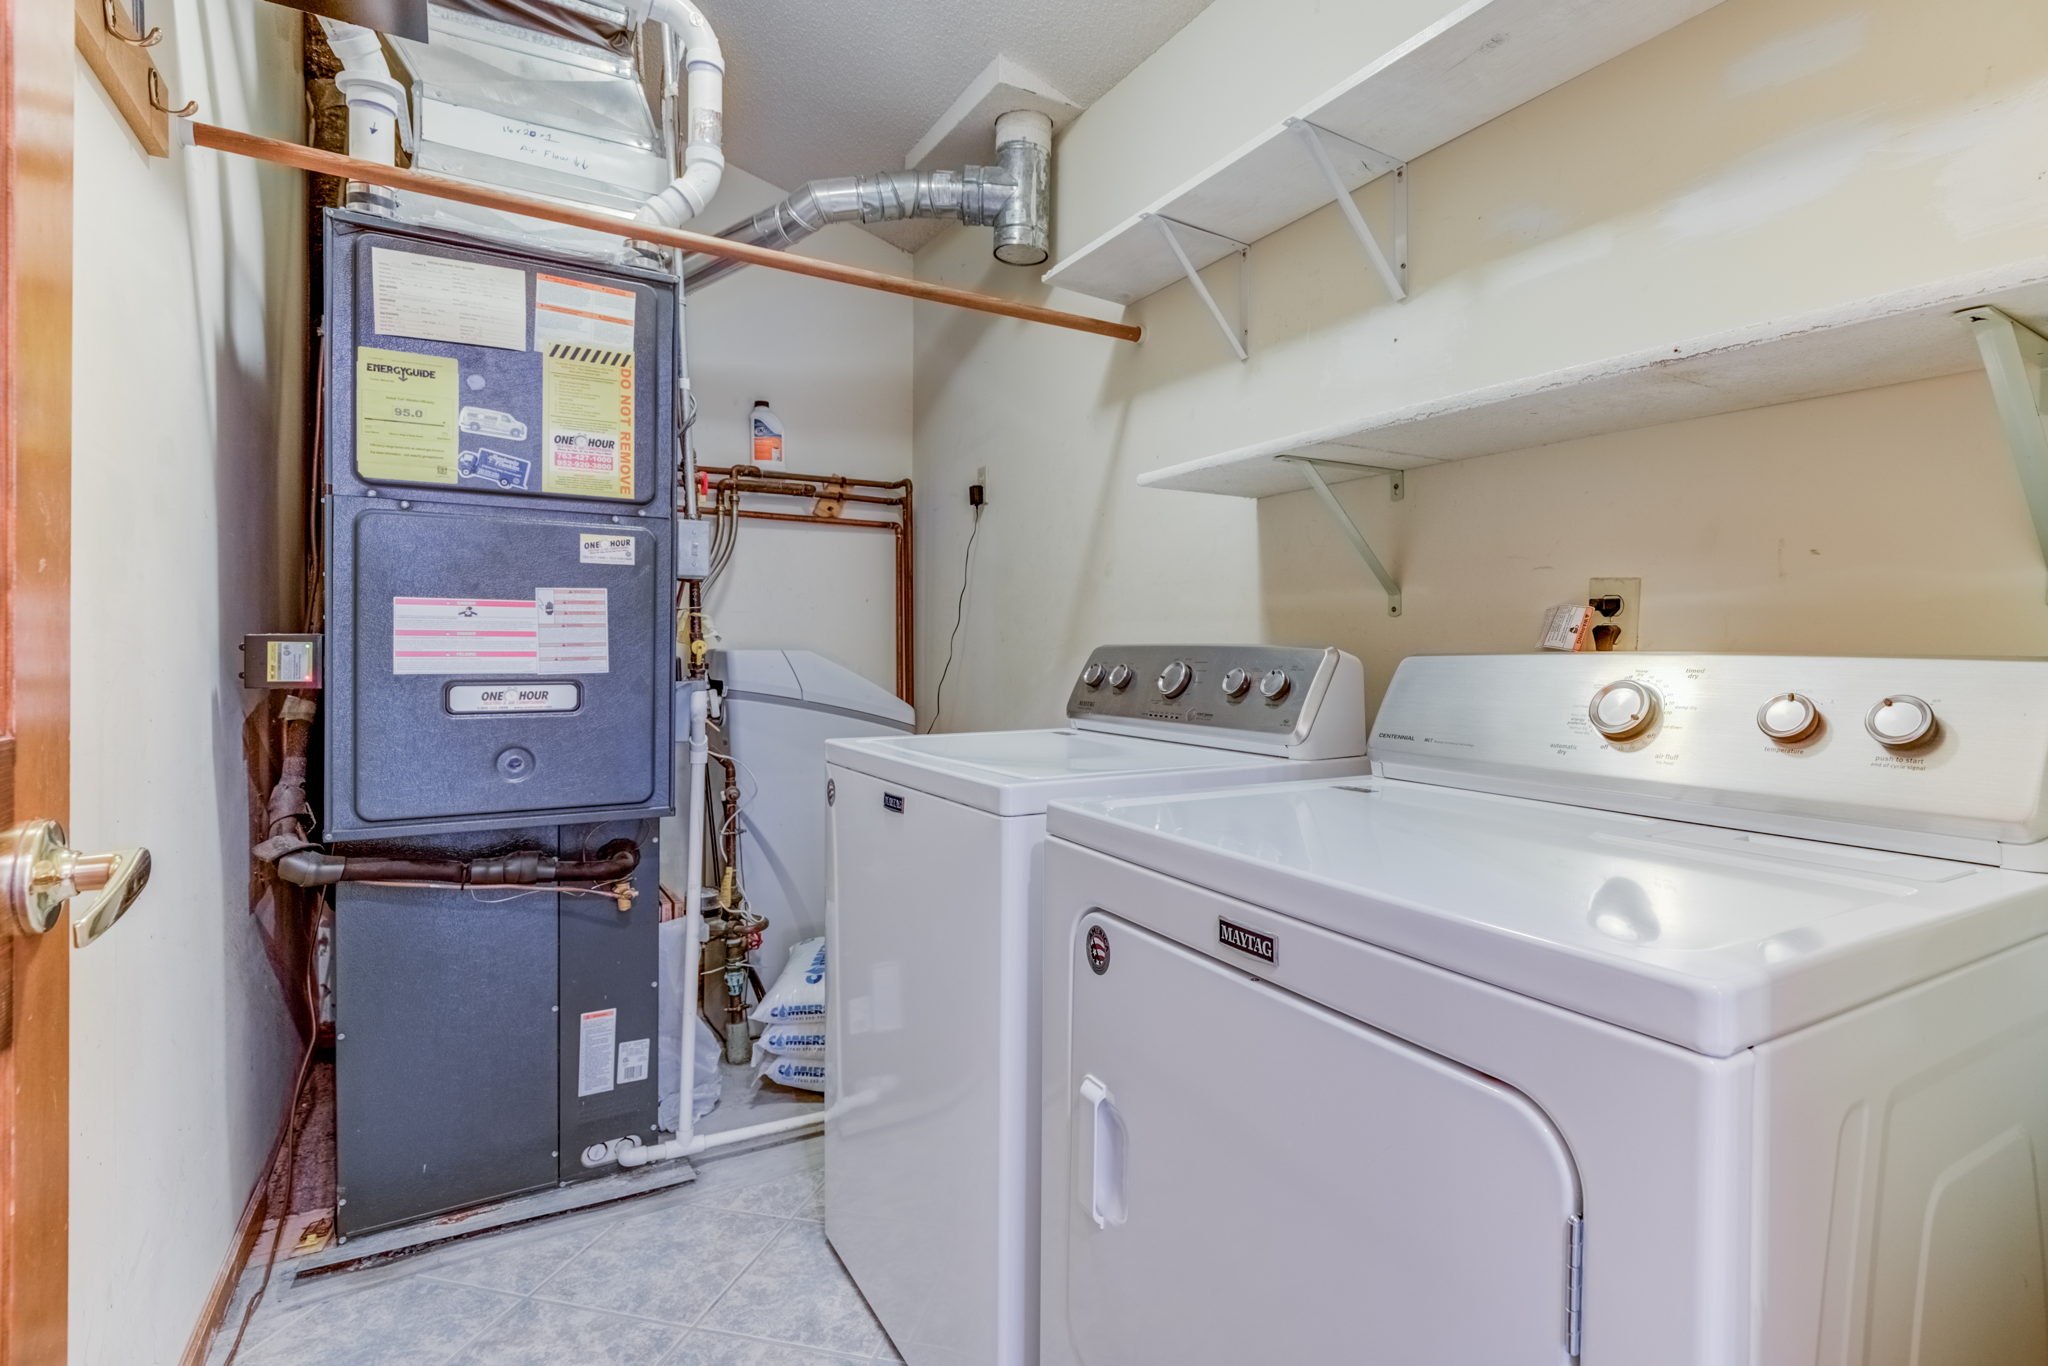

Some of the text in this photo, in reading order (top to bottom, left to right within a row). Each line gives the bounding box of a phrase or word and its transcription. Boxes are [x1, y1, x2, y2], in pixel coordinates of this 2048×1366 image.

[366, 362, 437, 381] ENERGYGUIDE
[394, 407, 423, 418] 95.0
[620, 367, 632, 495] DO NOT REMOVE
[554, 434, 615, 449] ONE HOUR
[584, 541, 600, 550] ONE
[610, 539, 631, 547] HOUR
[481, 690, 549, 701] ONE HOUR
[1378, 732, 1415, 742] CENTENNIAL
[1764, 746, 1804, 755] temperature
[1220, 924, 1273, 957] MAYTAG
[770, 1004, 825, 1018] COMMER
